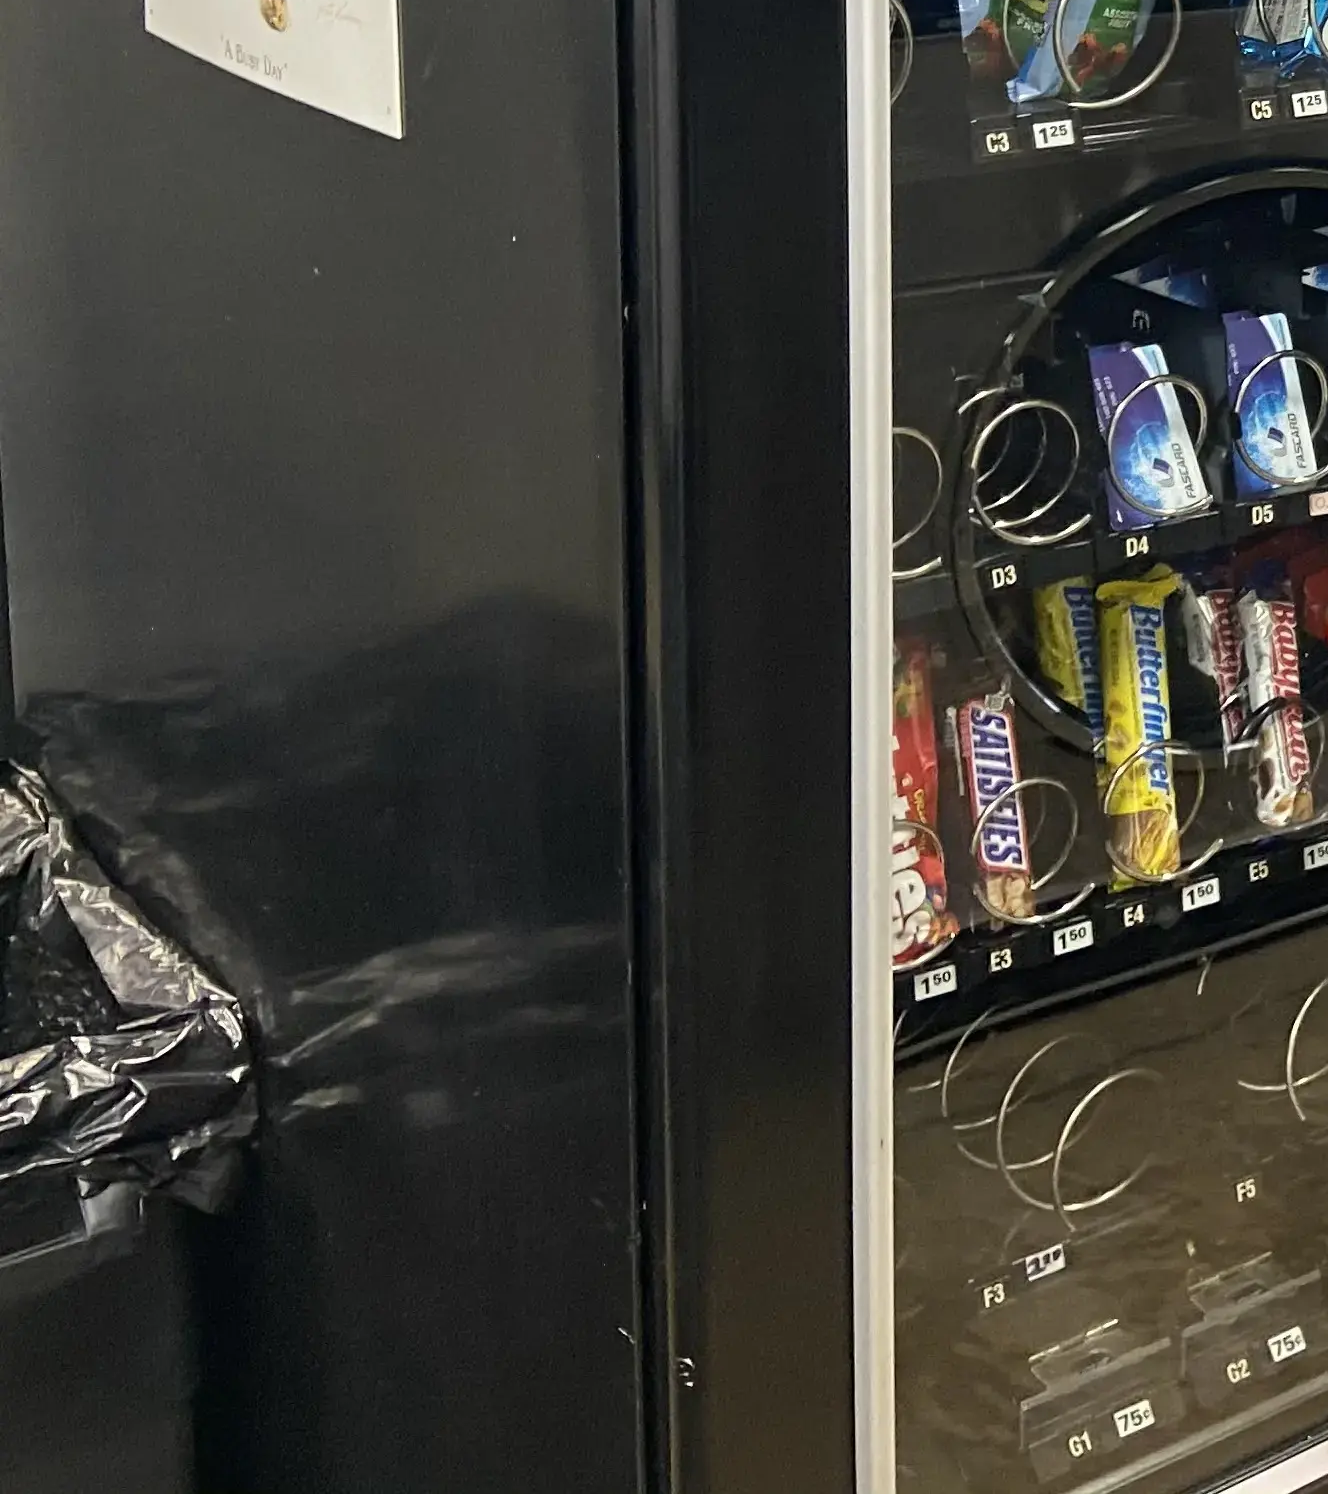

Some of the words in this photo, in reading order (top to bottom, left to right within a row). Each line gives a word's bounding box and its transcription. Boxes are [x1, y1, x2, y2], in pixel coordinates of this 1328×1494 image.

[1251, 101, 1272, 119] C5
[986, 133, 1009, 154] C3
[1287, 412, 1307, 469] FASCARD
[1171, 443, 1196, 499] FASCARD
[1252, 505, 1274, 525] D5
[1126, 537, 1149, 557] D4
[992, 565, 1017, 588] D3
[1132, 606, 1170, 796] Butterfinger
[970, 706, 1022, 868] SATISFIES
[1249, 861, 1269, 881] E5
[1124, 905, 1144, 927] E4
[991, 948, 1013, 972] E3
[1236, 1179, 1256, 1202] F5
[983, 1282, 1004, 1308] F3
[1227, 1359, 1250, 1383] G2
[1068, 1432, 1093, 1457] G1
